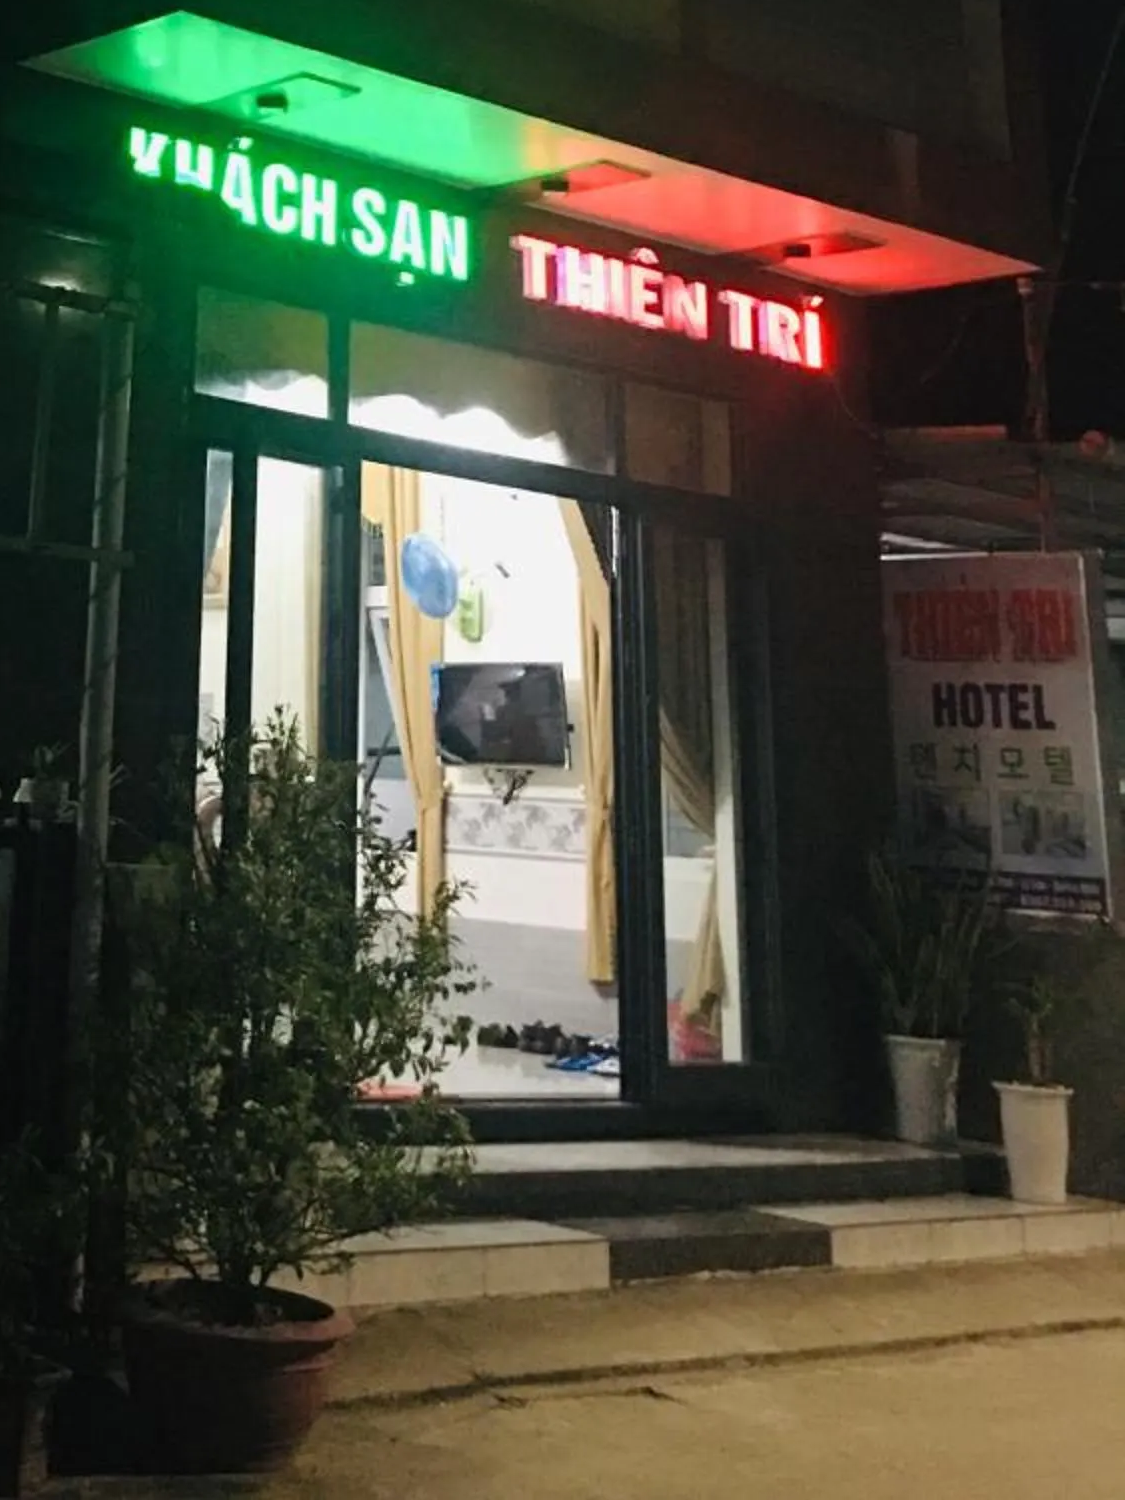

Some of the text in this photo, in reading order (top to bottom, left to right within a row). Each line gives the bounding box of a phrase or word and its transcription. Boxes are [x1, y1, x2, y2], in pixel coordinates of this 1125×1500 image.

[350, 186, 468, 287] SẠN
[510, 234, 708, 340] THIÊN
[718, 289, 823, 368] TRÍ
[931, 682, 1056, 730] HOTEL
